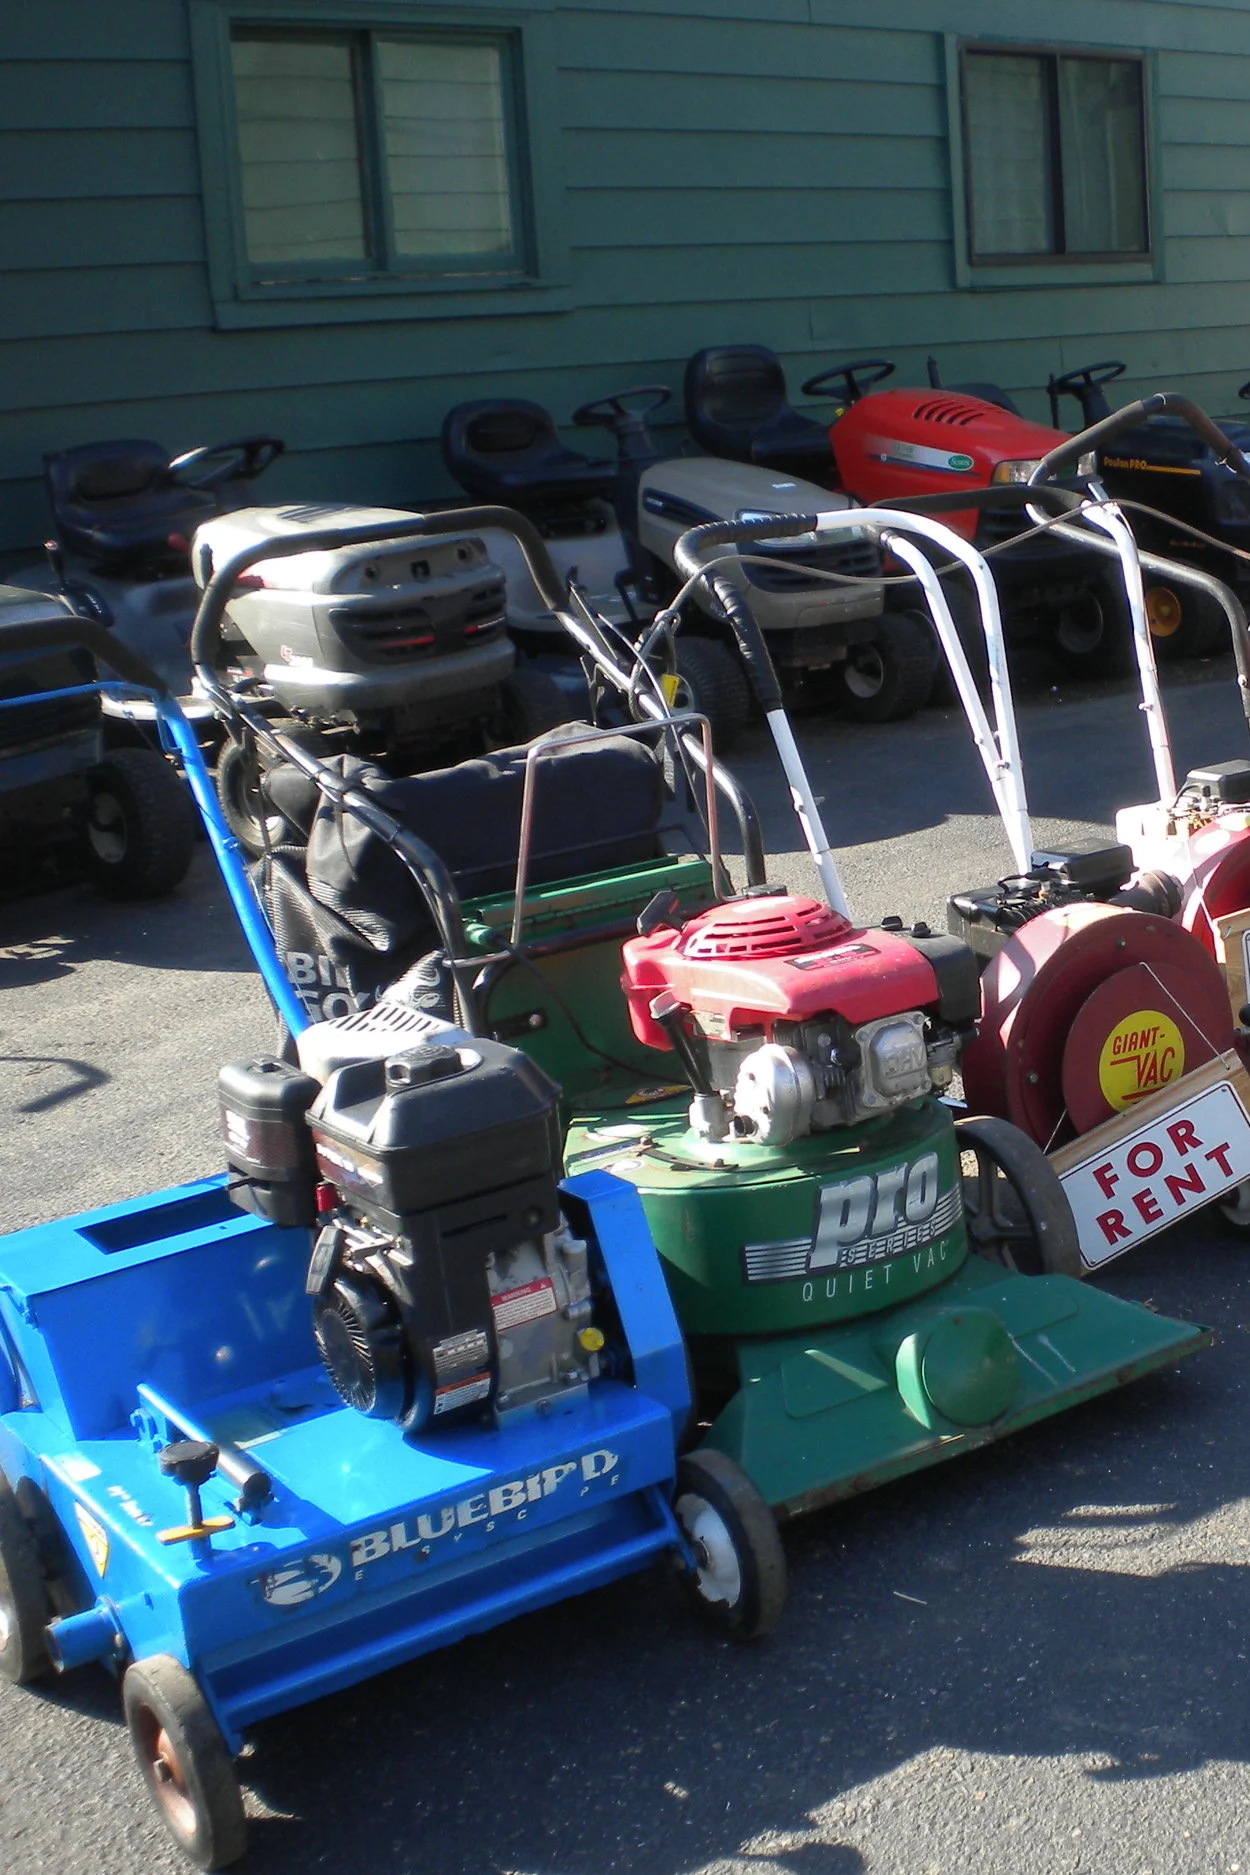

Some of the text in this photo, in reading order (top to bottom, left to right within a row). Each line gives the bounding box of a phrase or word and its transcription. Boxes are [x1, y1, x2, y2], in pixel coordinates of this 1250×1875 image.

[1113, 1026, 1166, 1056] GIANT-
[1135, 1046, 1176, 1089] VAC
[1092, 1119, 1204, 1200] FOR
[1095, 1141, 1231, 1246] RENT
[845, 1220, 938, 1265] SERIES
[802, 1244, 947, 1302] QUIET VAC
